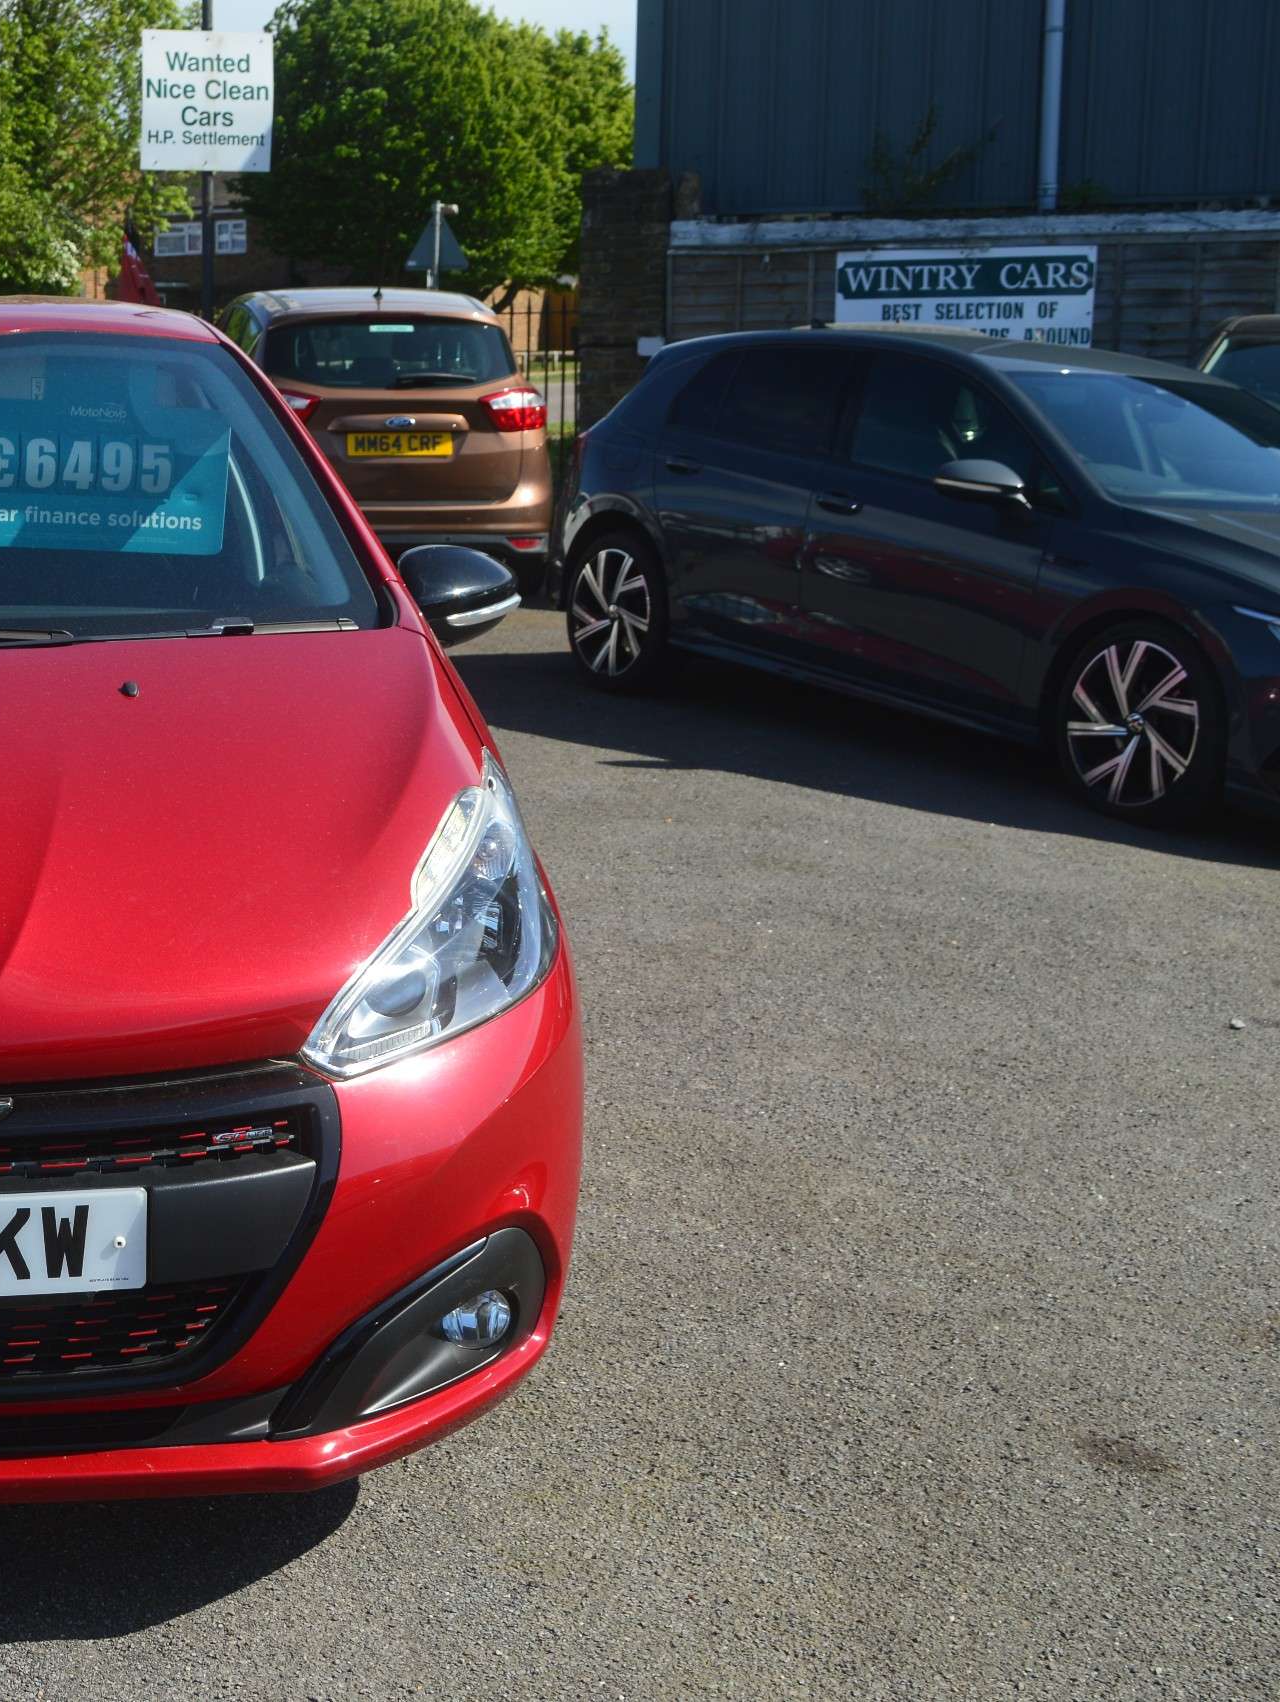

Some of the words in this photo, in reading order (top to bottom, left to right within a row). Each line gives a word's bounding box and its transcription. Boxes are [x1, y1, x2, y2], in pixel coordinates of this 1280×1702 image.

[165, 51, 251, 73] Wanted
[146, 78, 196, 99] Nice
[205, 80, 269, 101] Clean
[181, 105, 234, 127] Cars
[147, 130, 176, 144] H.P.
[182, 130, 265, 146] Settlement
[845, 264, 982, 292] WINTRY
[999, 262, 1089, 289] CARS
[881, 303, 922, 321] BEST
[935, 302, 1024, 321] SELECTION
[1037, 302, 1059, 319] OF
[25, 506, 100, 526] finance
[107, 511, 202, 530] solutions
